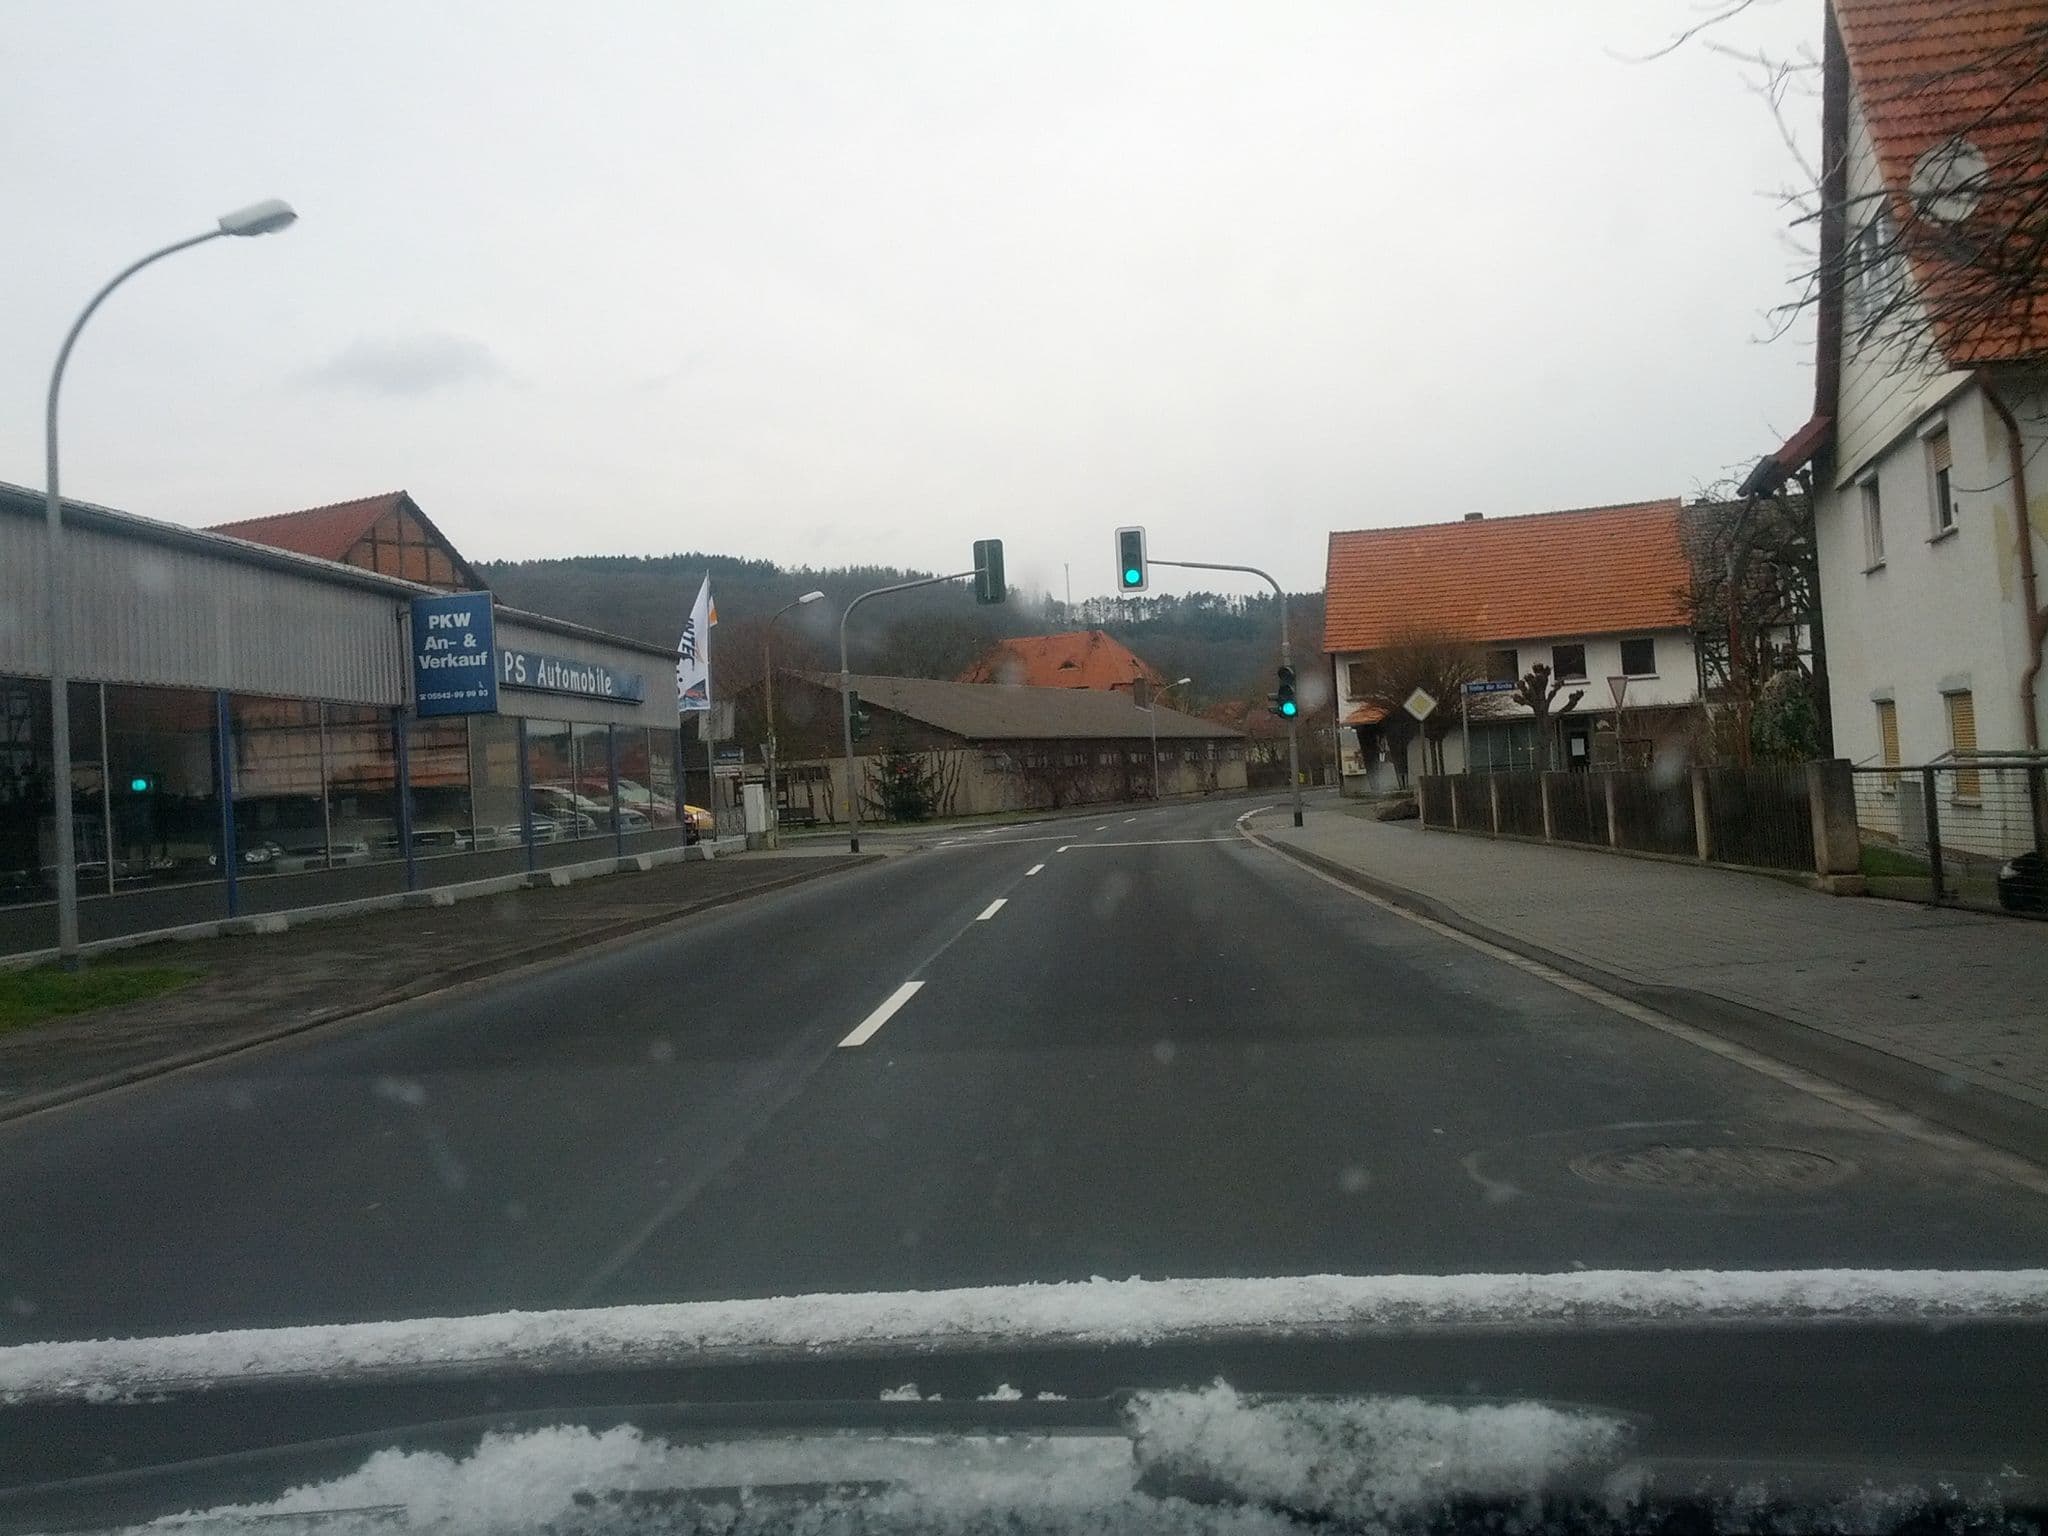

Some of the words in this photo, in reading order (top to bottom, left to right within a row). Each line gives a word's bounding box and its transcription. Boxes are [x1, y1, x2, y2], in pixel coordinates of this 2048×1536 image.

[428, 612, 471, 629] PKW
[424, 636, 457, 651] An-
[463, 633, 477, 647] &
[419, 651, 488, 670] Verkauf
[504, 651, 526, 683] PS
[537, 658, 612, 695] Automobile
